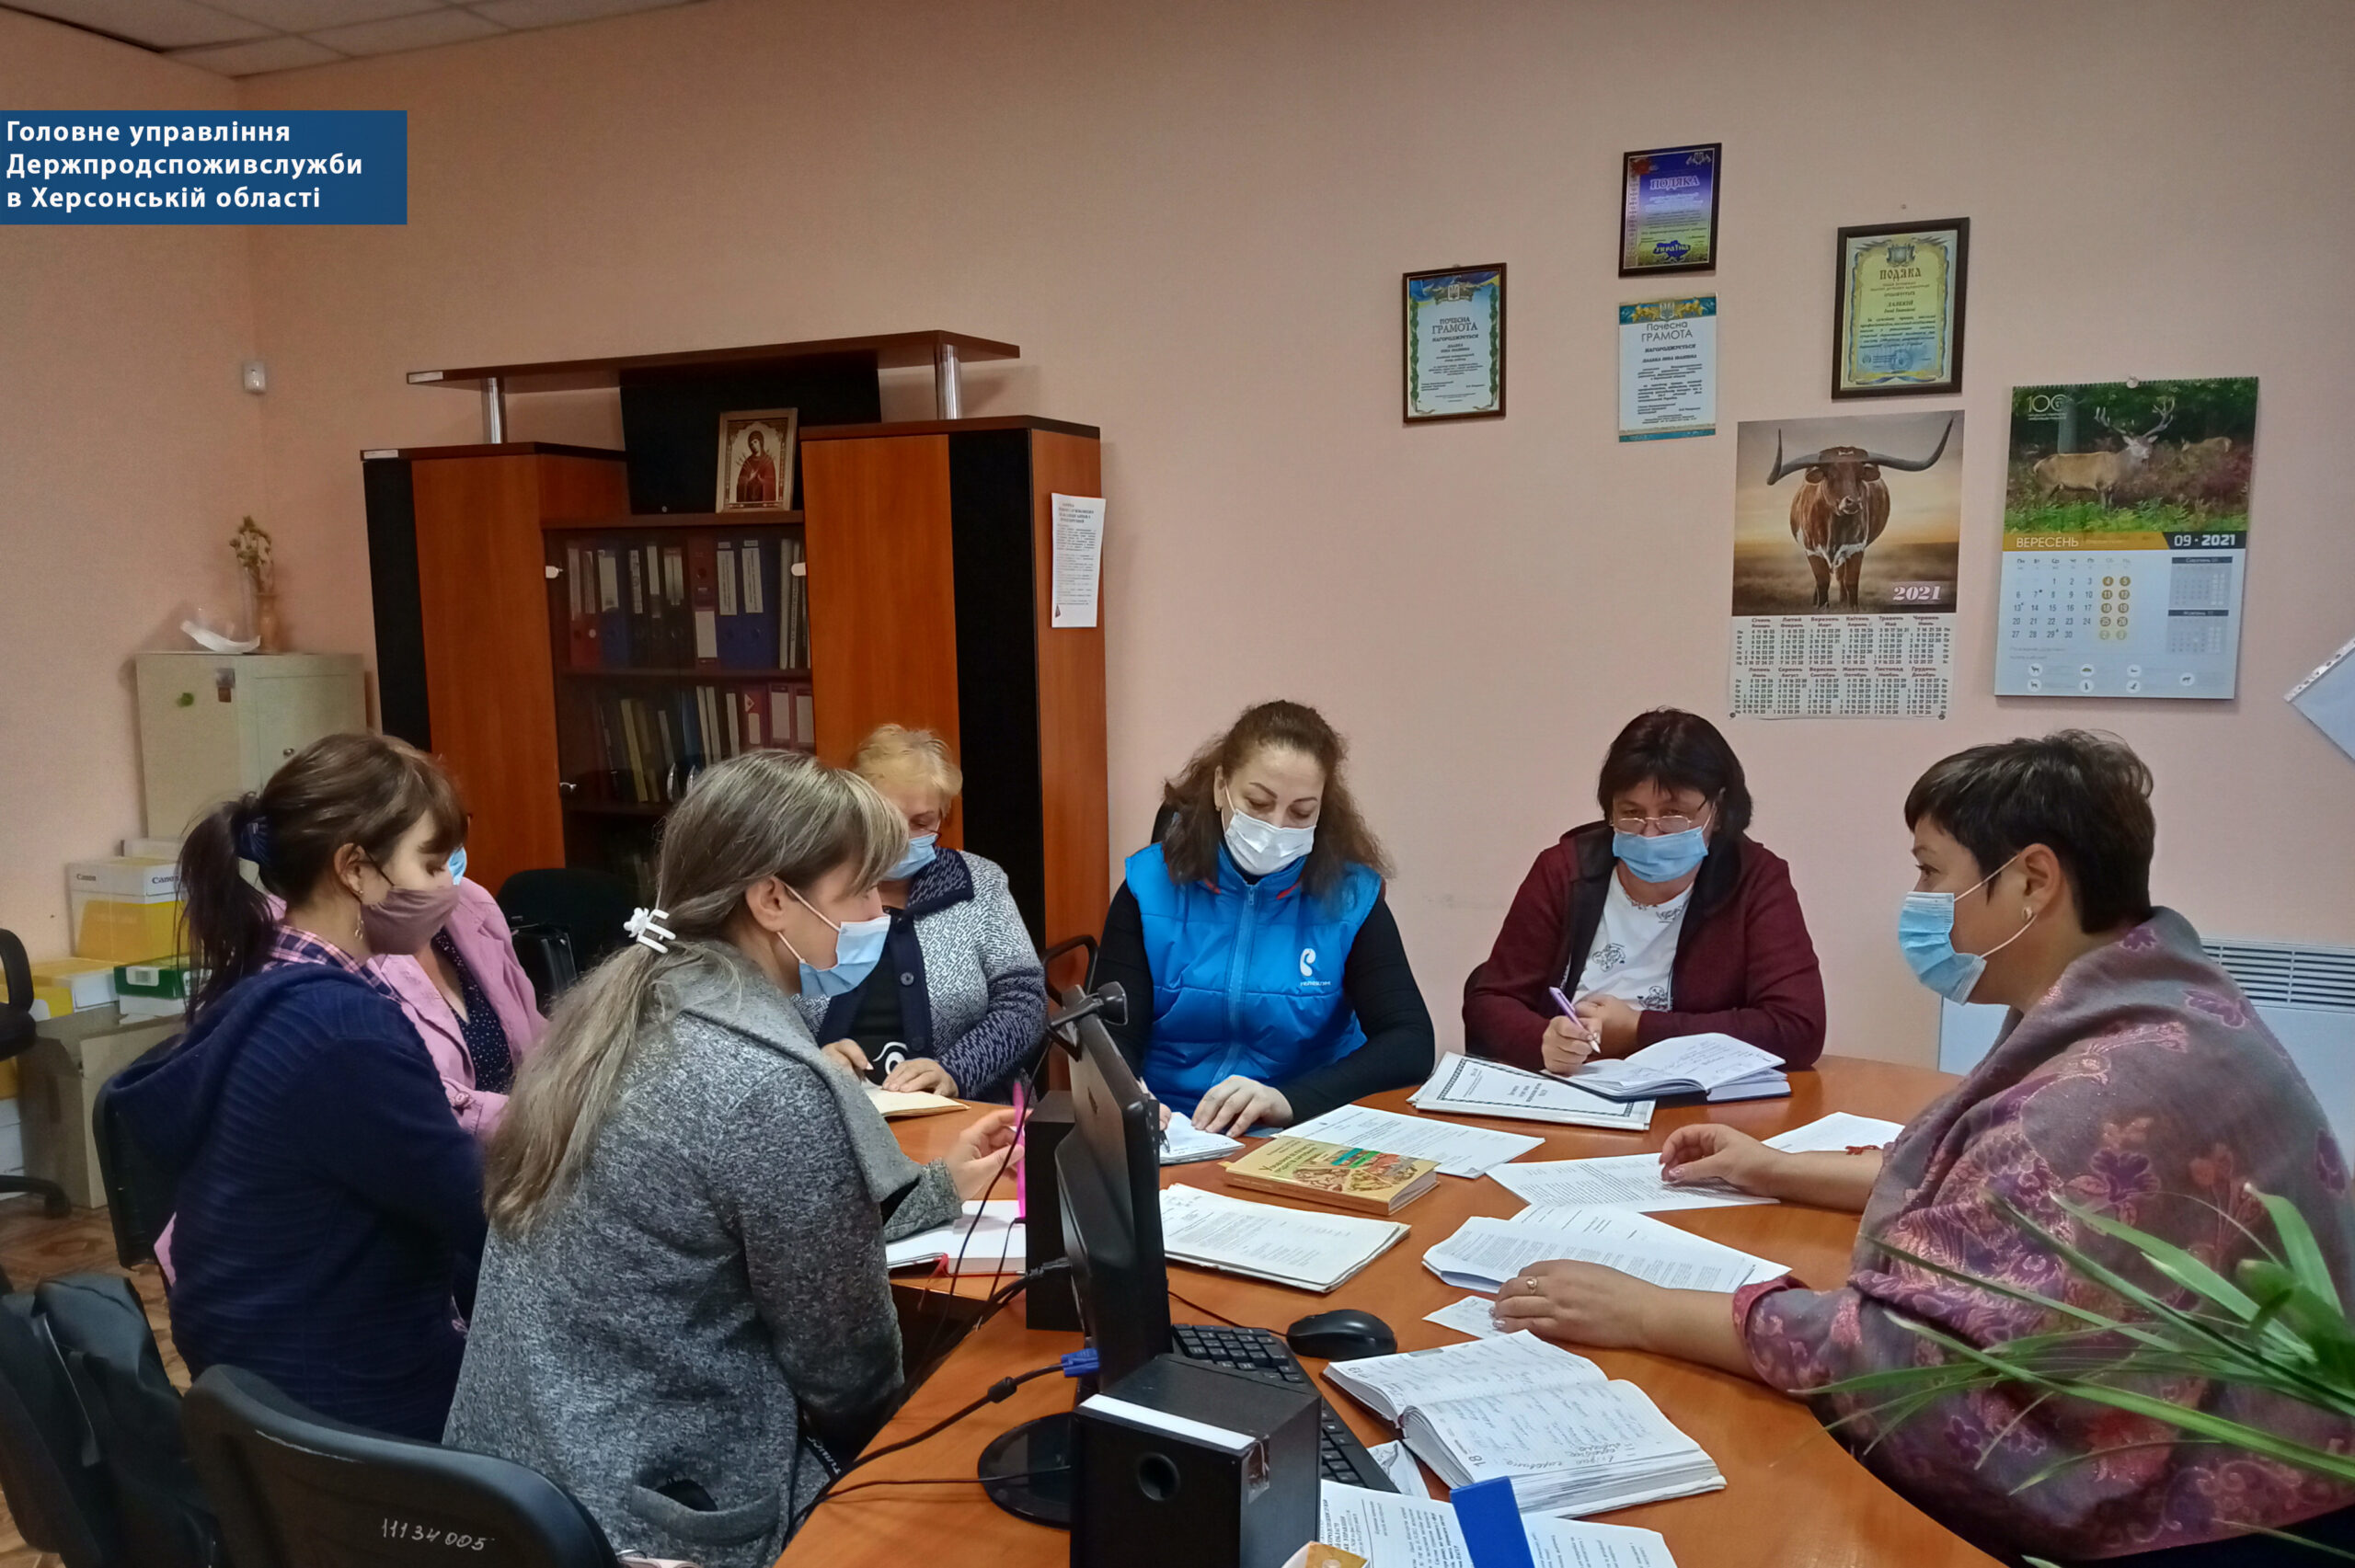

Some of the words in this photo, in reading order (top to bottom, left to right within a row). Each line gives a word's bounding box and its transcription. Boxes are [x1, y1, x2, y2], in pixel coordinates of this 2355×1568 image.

[1650, 176, 1700, 190] ПОДЯКА
[1880, 268, 1921, 281] ПОДЯКА
[1432, 322, 1477, 334] ГРАМОТА
[1648, 322, 1687, 331] Почесна
[1642, 329, 1693, 342] ГРАМОТА
[2016, 537, 2079, 548] ВЕРЕСЕНЬ
[2175, 535, 2191, 546] 09
[2201, 534, 2235, 545] 2021
[1893, 586, 1941, 601] 2021
